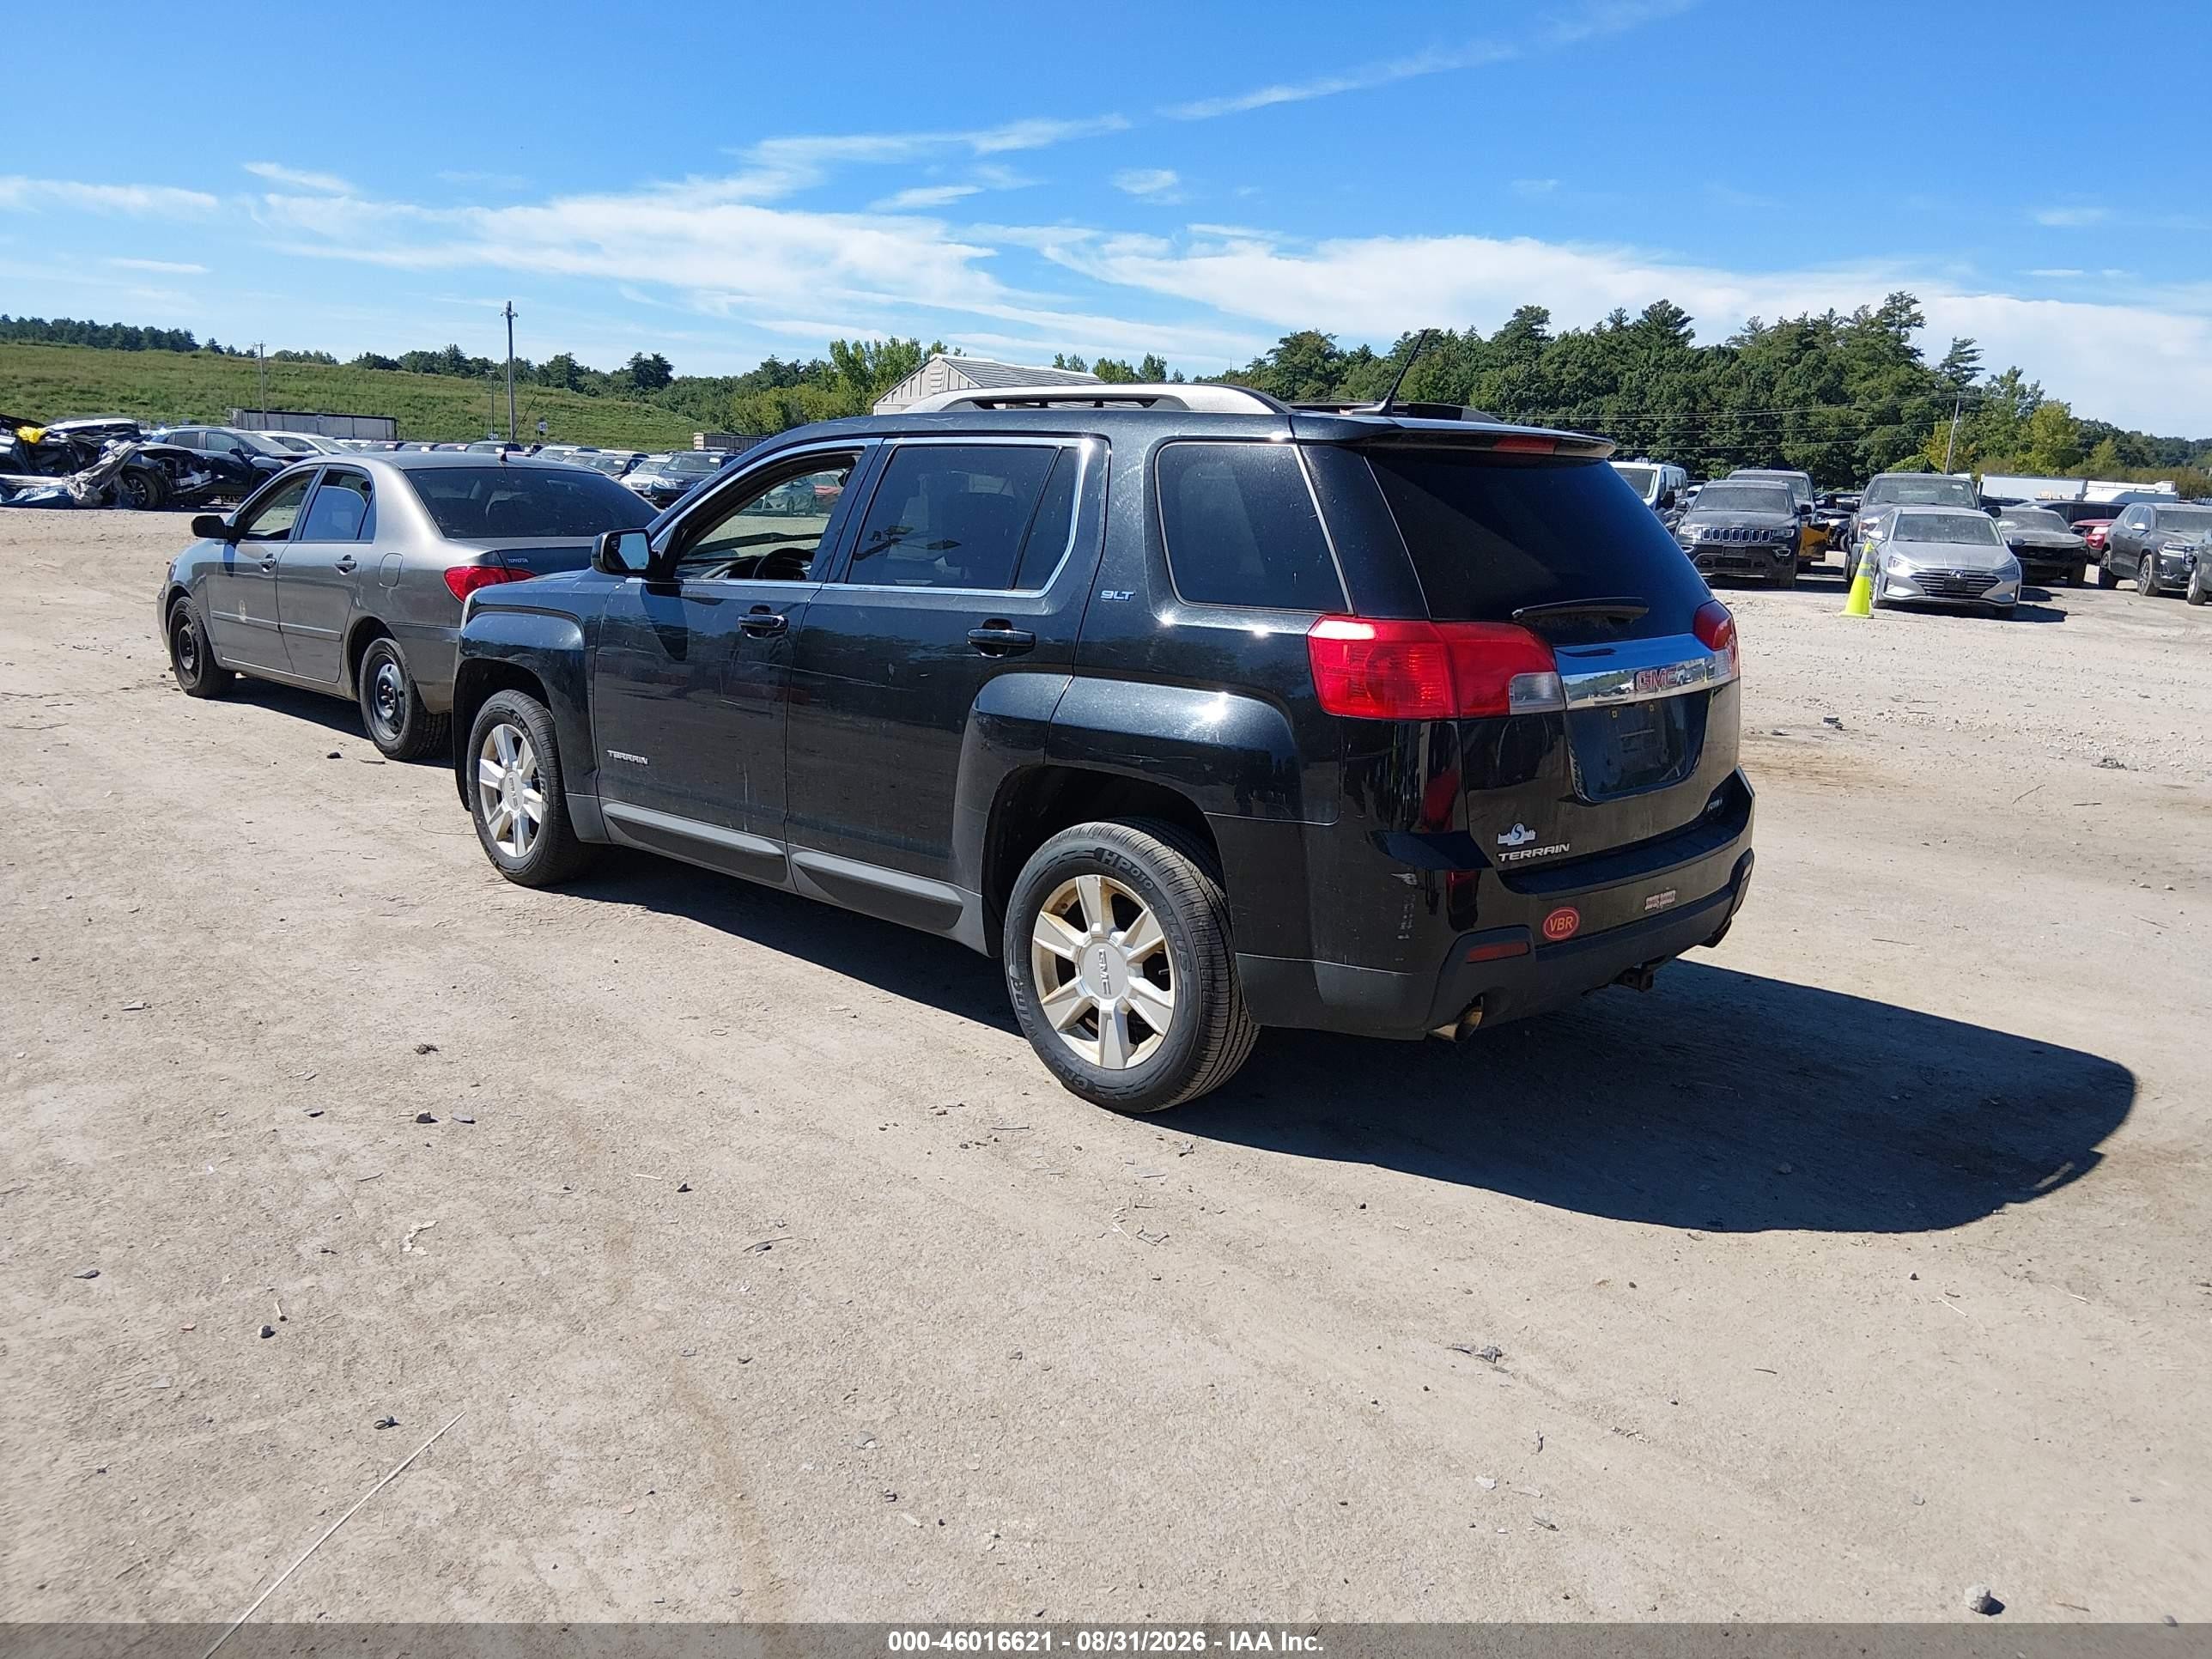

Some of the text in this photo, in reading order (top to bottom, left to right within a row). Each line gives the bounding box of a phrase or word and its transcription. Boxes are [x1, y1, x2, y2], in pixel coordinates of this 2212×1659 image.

[1100, 590, 1134, 600] SLT
[1636, 667, 1677, 690] GMC
[606, 750, 648, 765] TERRAIN
[1498, 842, 1571, 862] TERRAIN
[1100, 849, 1154, 890] HP010
[1548, 915, 1574, 933] VBR
[1098, 948, 1112, 995] GMC
